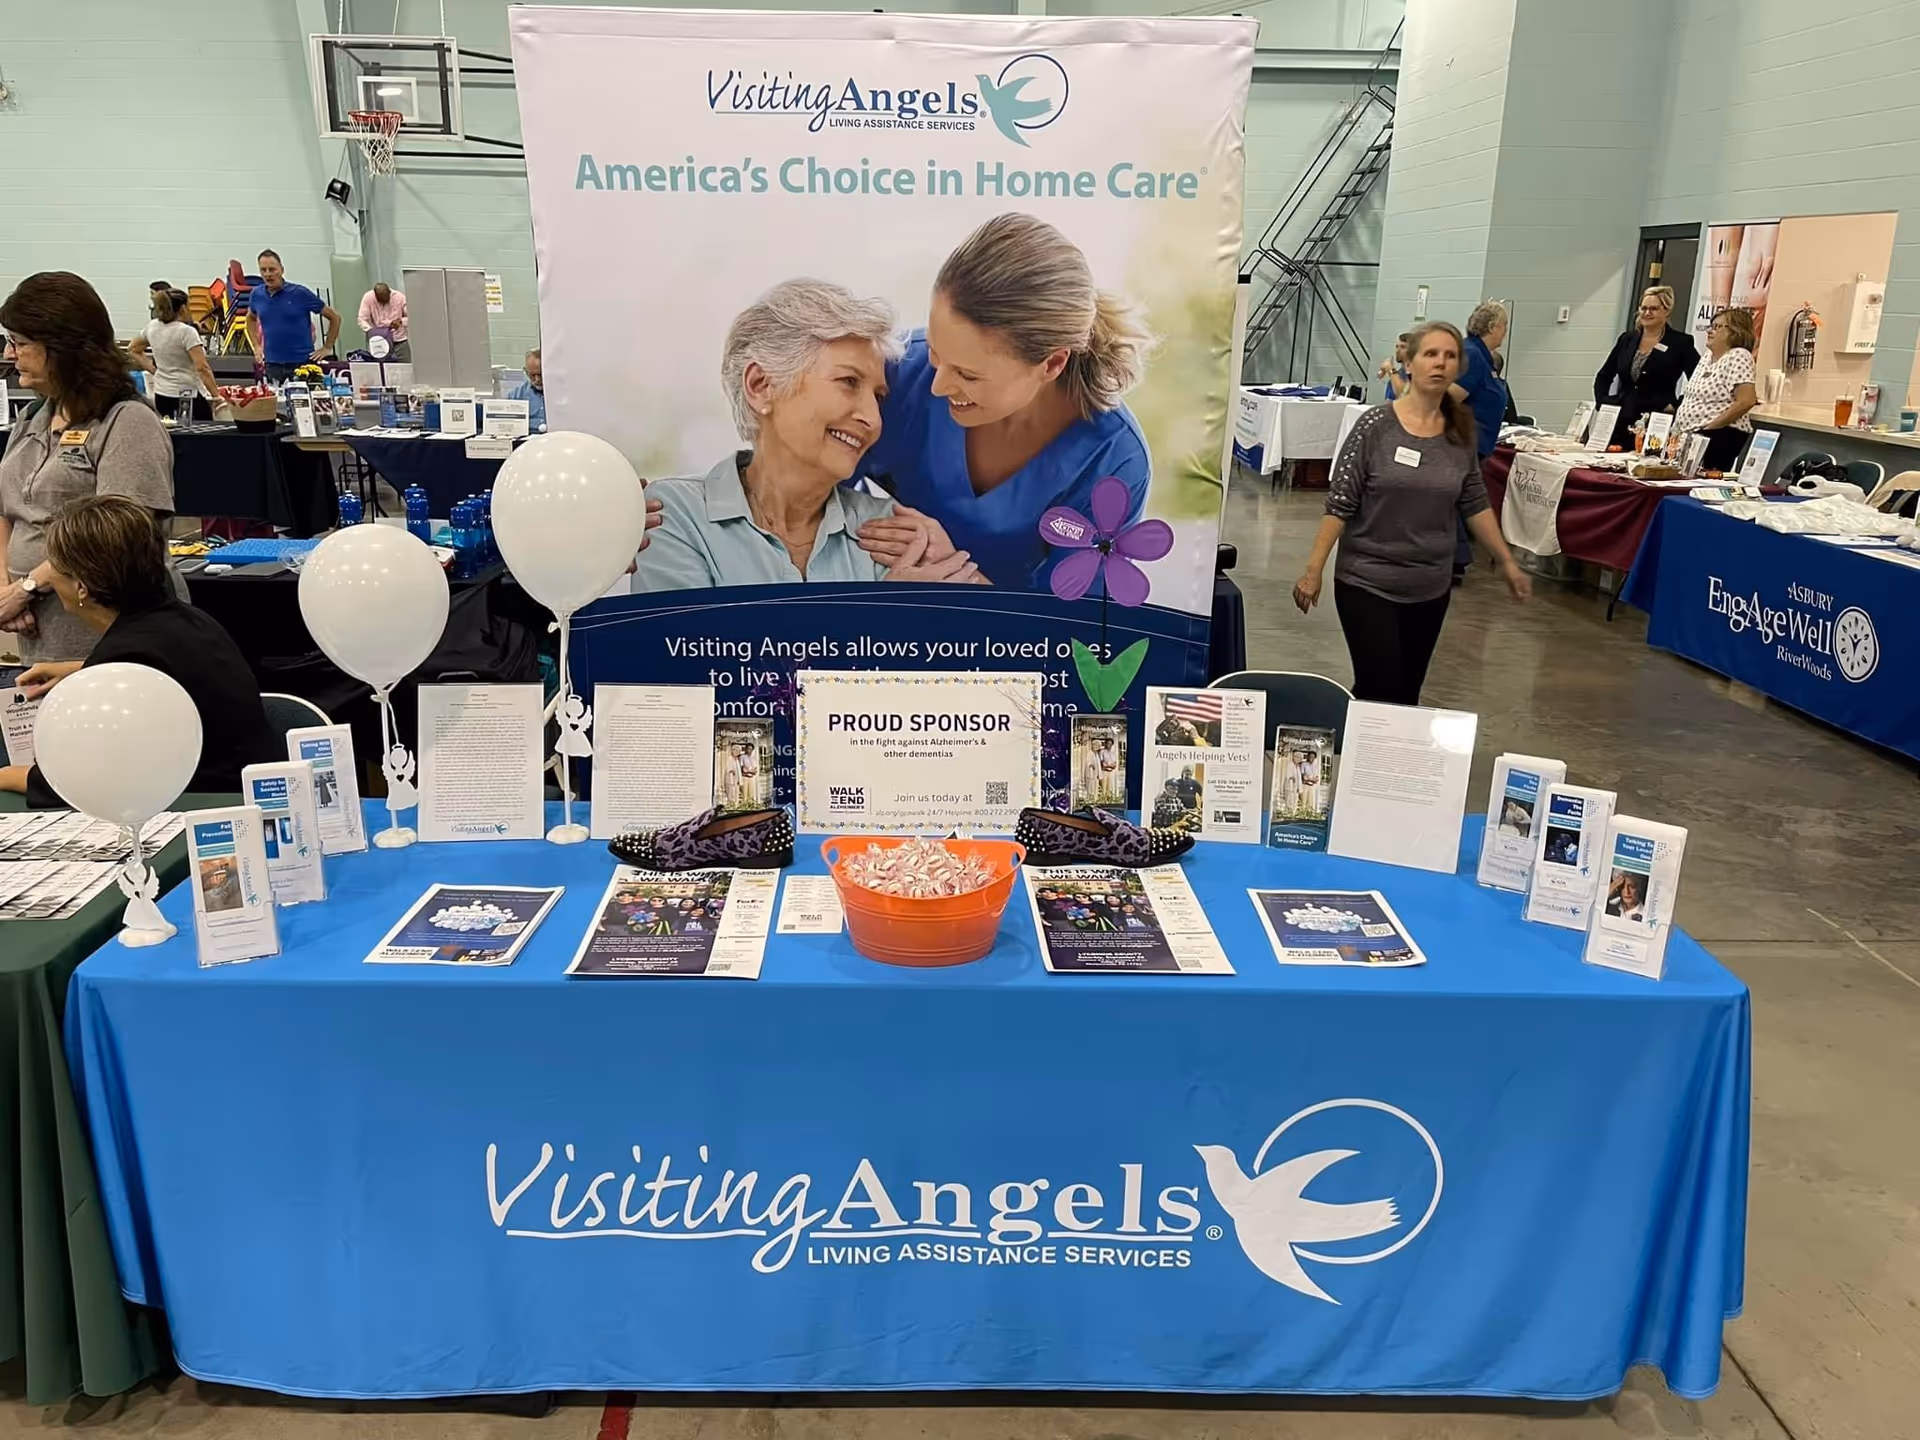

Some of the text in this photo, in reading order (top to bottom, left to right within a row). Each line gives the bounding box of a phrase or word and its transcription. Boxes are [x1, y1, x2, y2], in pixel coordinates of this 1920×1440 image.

[829, 118, 975, 131] LIVING ASSISTANCE SERVICES
[575, 153, 1199, 199] America's Choice in Home Care
[1787, 581, 1834, 613] ASBURY
[665, 636, 1112, 662] Visiting Angels allows your loved oes
[1776, 645, 1832, 682] RiverWoods
[708, 669, 733, 687] to
[740, 666, 779, 687] live
[828, 713, 1011, 732] PROUD SPONSOR
[850, 737, 987, 748] in the fight against Alzheimer's &
[883, 750, 954, 759] other dementias
[1156, 749, 1251, 763] Angels Helping Vets!
[829, 786, 864, 796] WALK
[839, 796, 865, 805] END
[893, 793, 916, 802] Join
[932, 793, 960, 804] today
[962, 793, 973, 802] at
[1625, 837, 1646, 847] Talking
[808, 1242, 1192, 1268] LIVING ASSISTANCE SERVICES
